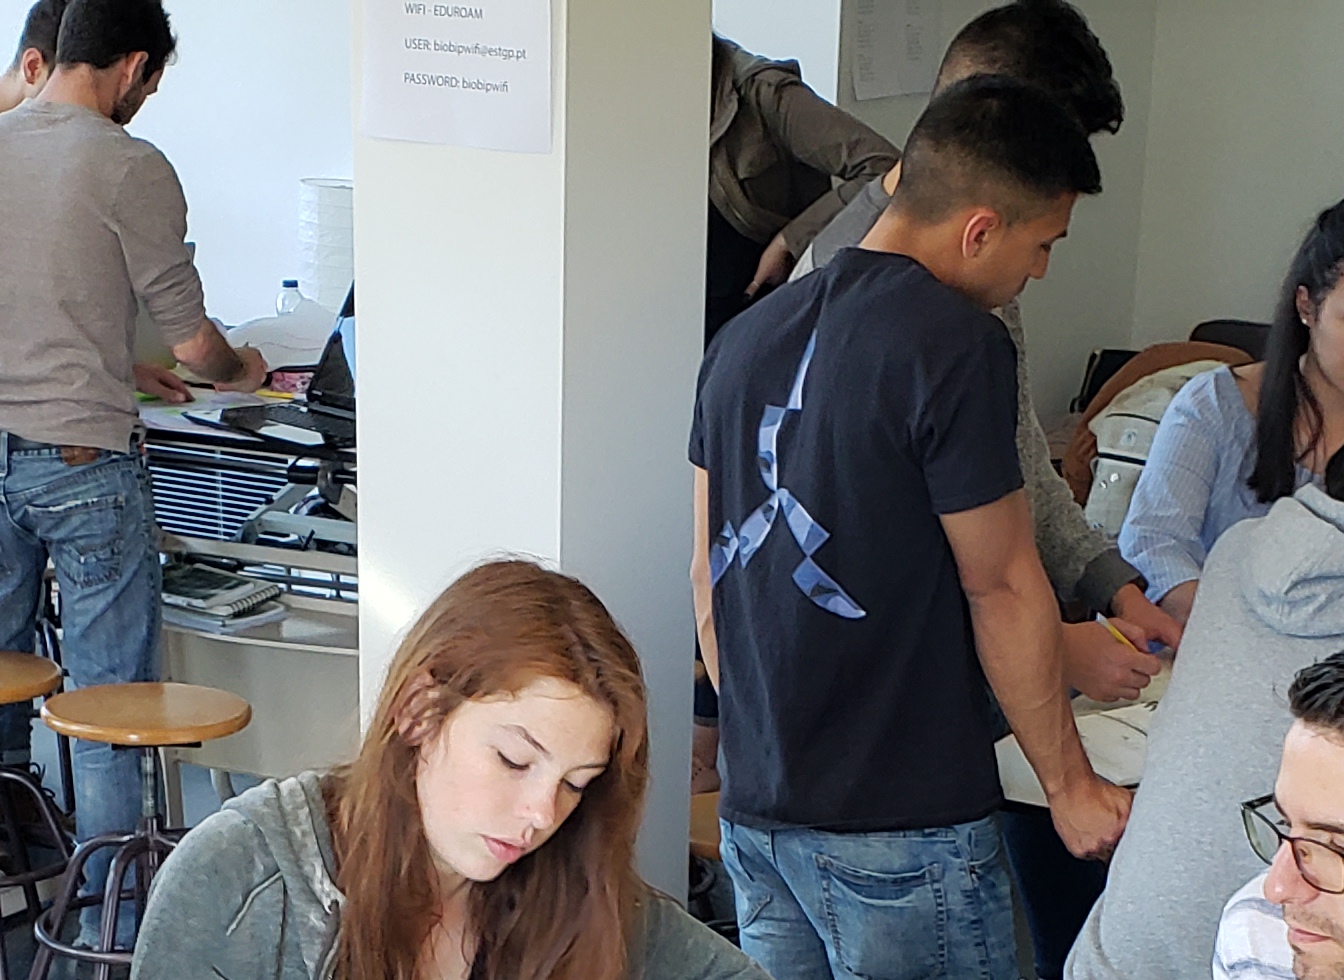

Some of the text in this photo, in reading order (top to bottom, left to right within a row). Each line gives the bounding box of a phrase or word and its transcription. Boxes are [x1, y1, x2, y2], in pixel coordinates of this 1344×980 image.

[404, 3, 426, 15] WIFI
[433, 4, 483, 19] EDUROAM
[404, 38, 431, 50] USER:
[403, 72, 460, 88] PASSWORD:
